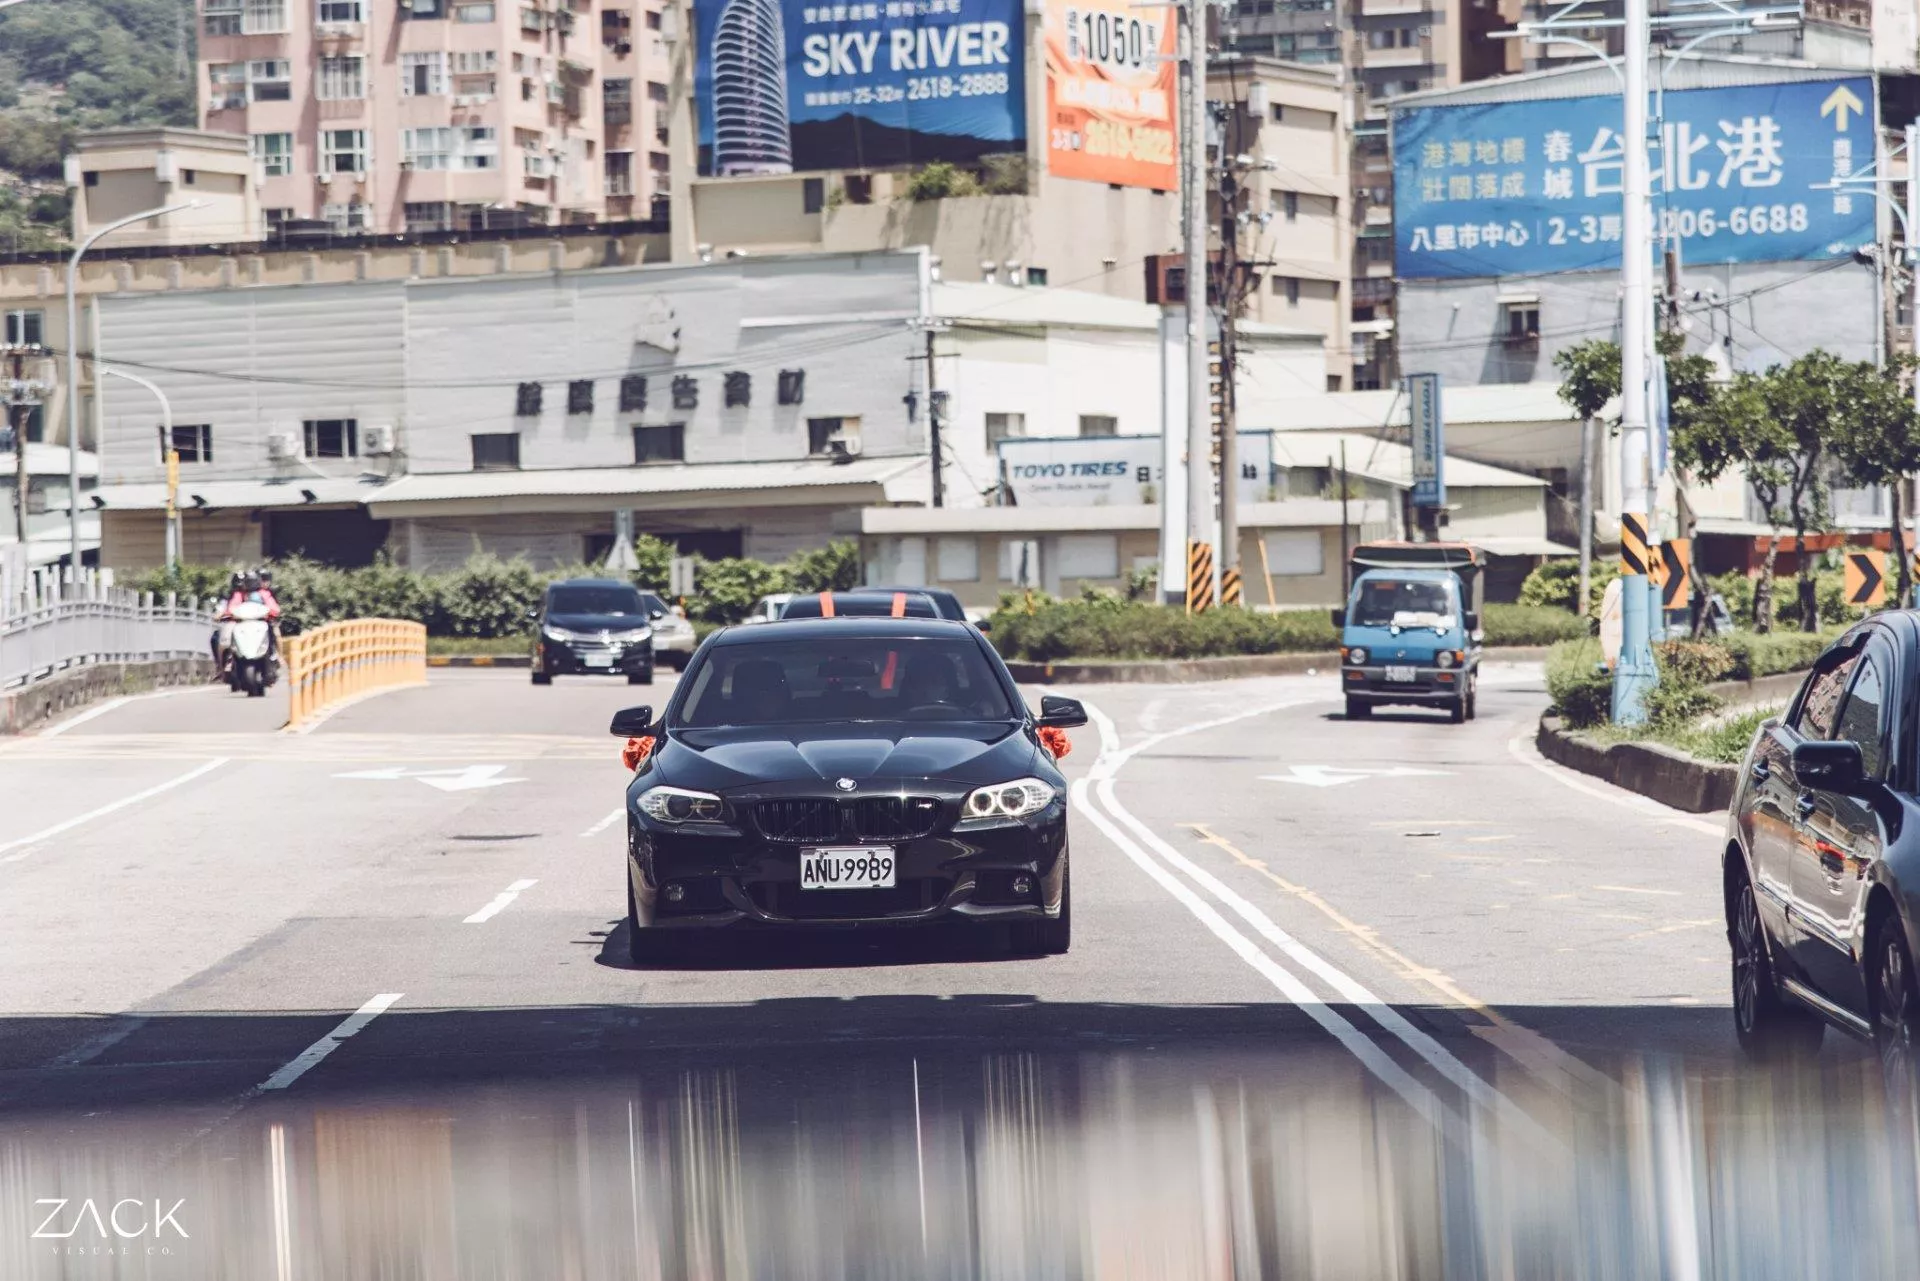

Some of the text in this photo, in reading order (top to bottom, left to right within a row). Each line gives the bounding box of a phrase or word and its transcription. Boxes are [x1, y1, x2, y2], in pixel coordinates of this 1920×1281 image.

[803, 32, 881, 78] SKY
[890, 21, 1010, 72] RIVER
[1083, 12, 1142, 68] 1050
[1543, 130, 1574, 199] 春城
[1576, 114, 1785, 198] 台北港
[1410, 219, 1530, 252] 八里市中心
[1013, 464, 1065, 478] TOYO
[1071, 461, 1128, 477] TIRES
